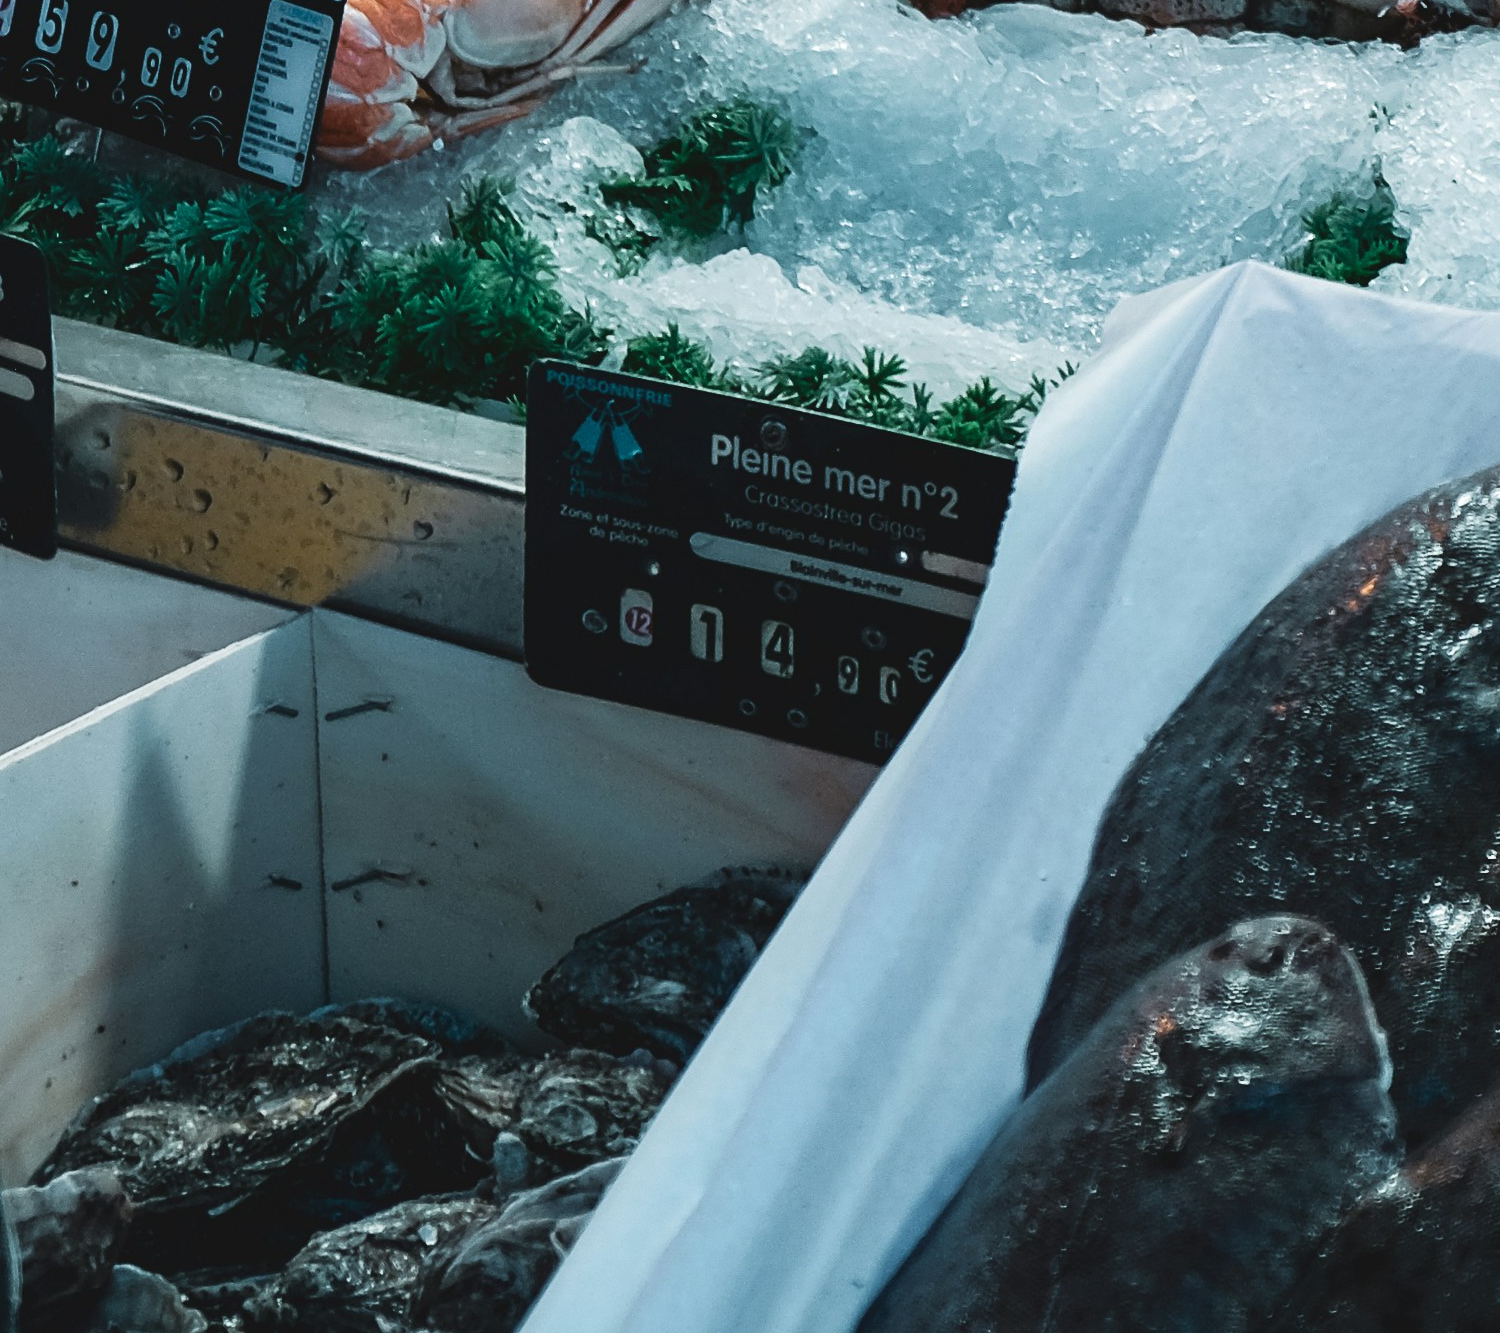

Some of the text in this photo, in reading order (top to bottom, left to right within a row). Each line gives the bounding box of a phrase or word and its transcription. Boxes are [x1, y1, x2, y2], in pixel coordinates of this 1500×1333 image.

[198, 27, 225, 66] €
[545, 369, 673, 409] POISSONNERIE
[710, 432, 961, 521] Pleine mer n°2
[559, 503, 594, 522] Zone
[588, 524, 606, 539] de
[723, 512, 754, 533] Type
[808, 532, 826, 547] de
[743, 484, 927, 544] Crassostrea Gigas
[907, 647, 935, 684] €
